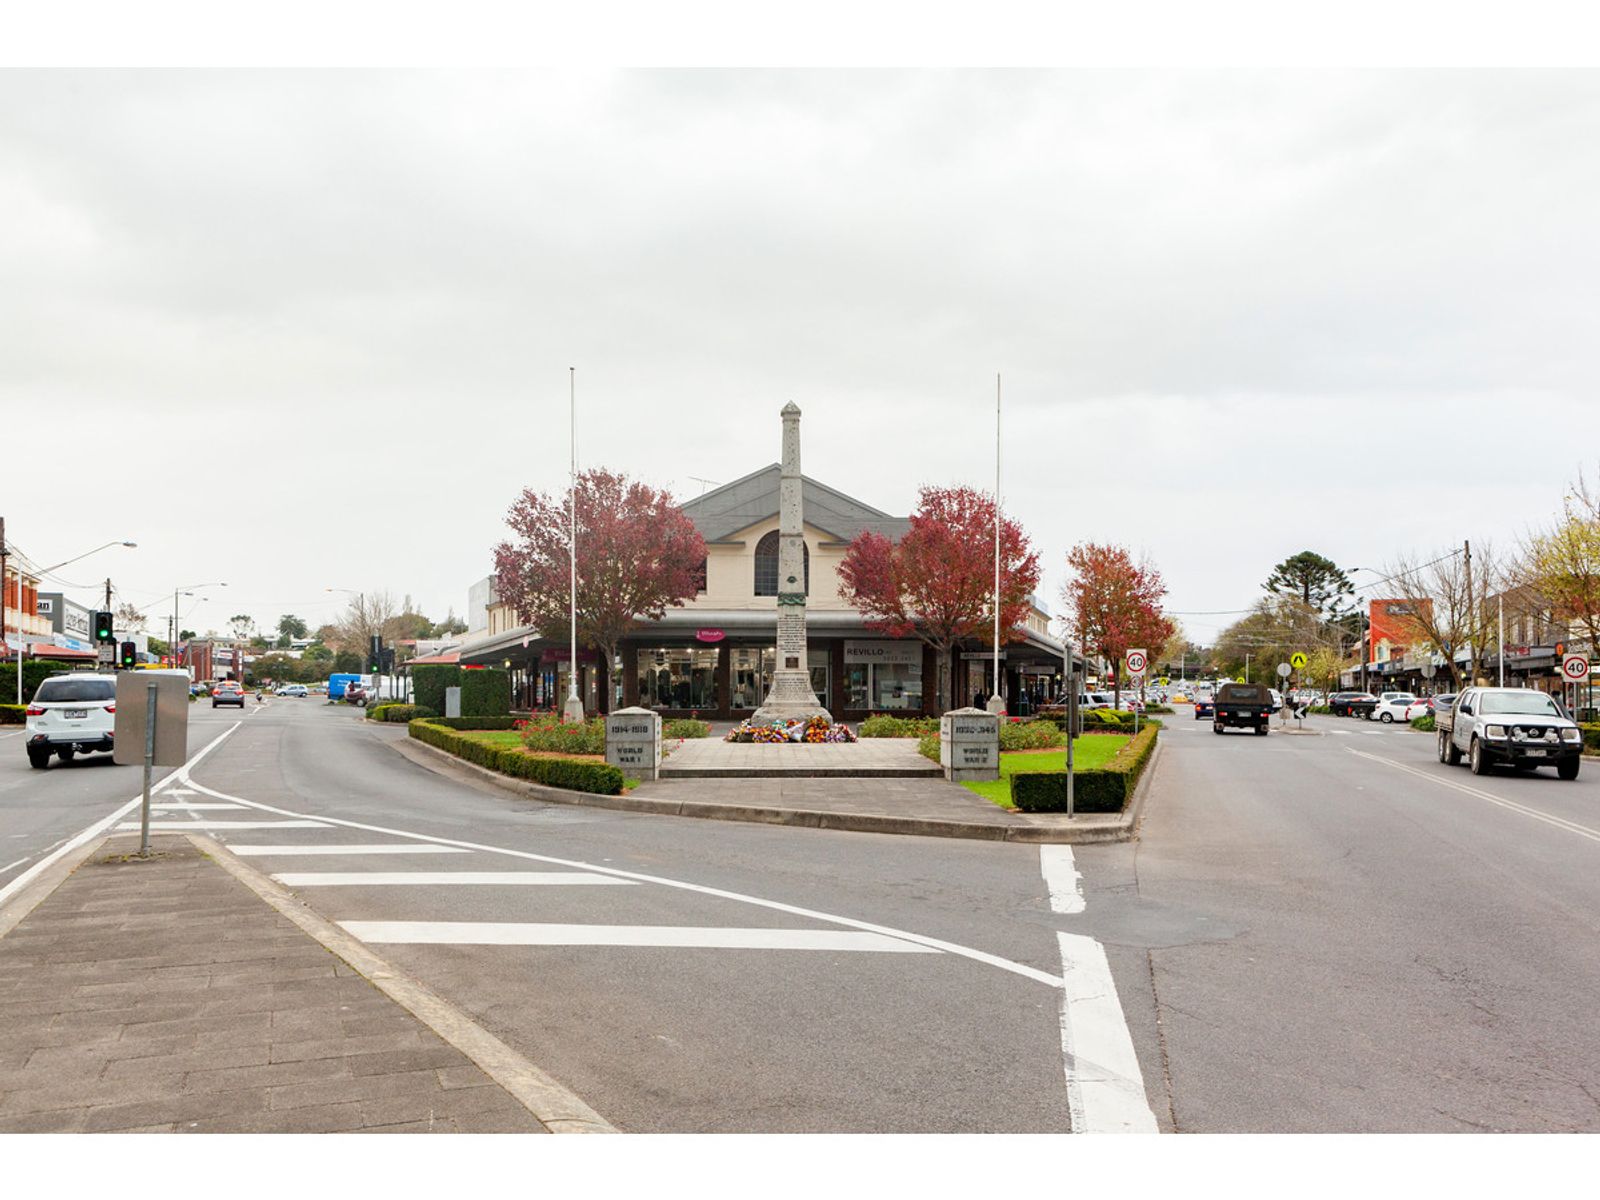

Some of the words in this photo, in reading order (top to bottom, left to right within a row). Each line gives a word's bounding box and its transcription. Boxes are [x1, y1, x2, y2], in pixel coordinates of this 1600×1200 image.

[846, 648, 884, 656] REVILLO
[1130, 657, 1143, 667] 40
[1568, 662, 1584, 673] 40
